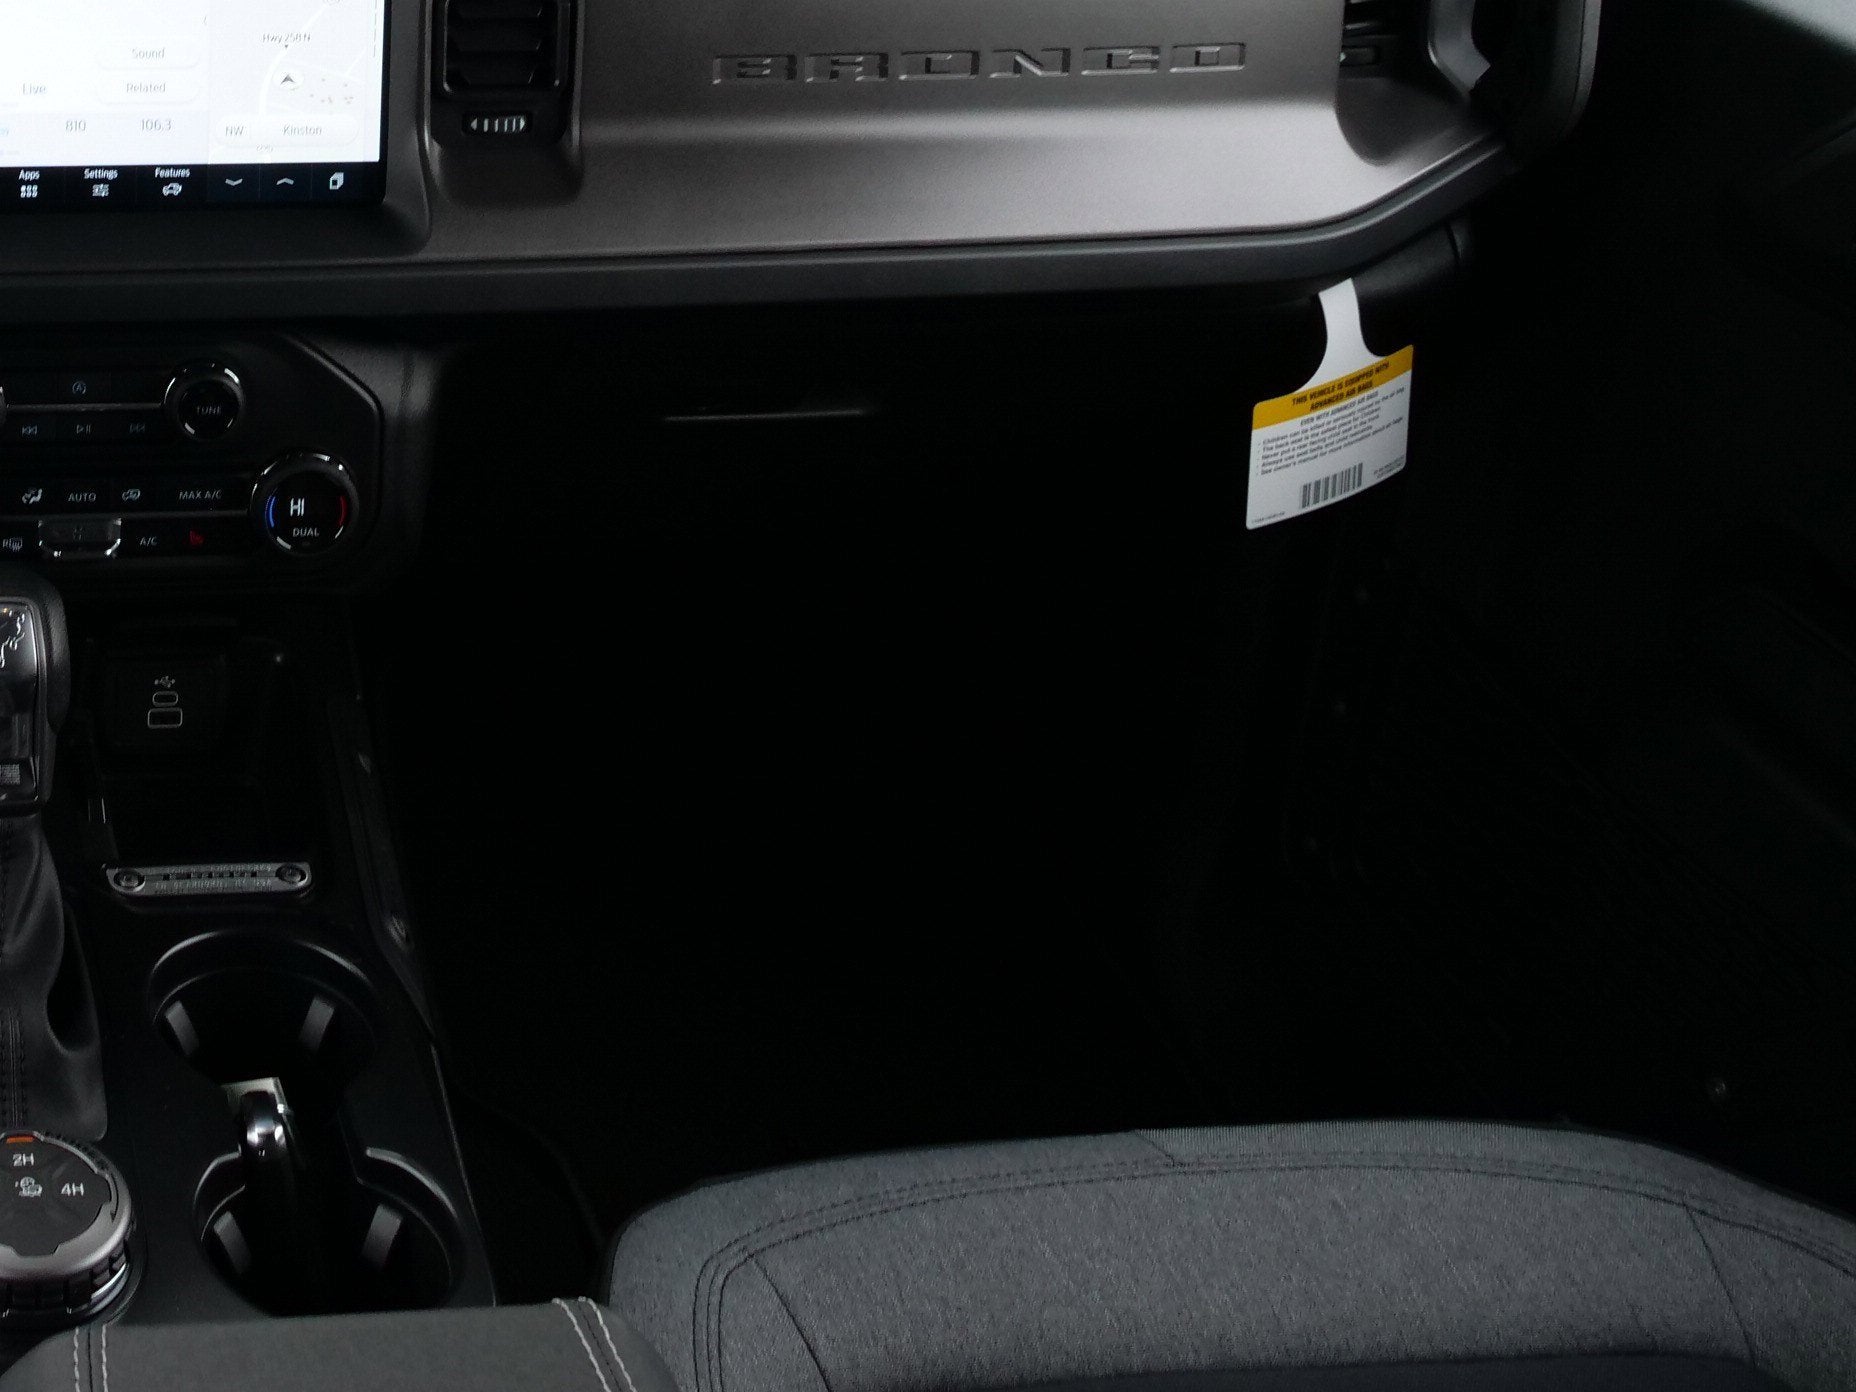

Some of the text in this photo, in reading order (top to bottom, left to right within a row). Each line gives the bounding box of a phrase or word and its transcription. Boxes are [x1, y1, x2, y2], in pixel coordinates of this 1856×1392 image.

[131, 48, 165, 60] Sound
[713, 42, 1246, 86] BRONCO
[23, 83, 47, 95] Live
[125, 82, 166, 93] Related
[140, 119, 173, 131] 106.3
[225, 126, 245, 136] NW
[283, 125, 322, 136] Kinston
[18, 169, 40, 181] Apps
[84, 168, 118, 180] Settings
[154, 167, 190, 178] Features
[68, 492, 96, 503] AUTO
[179, 489, 223, 500] MAX A/C
[290, 497, 305, 517] HI
[292, 527, 320, 538] DUAL
[139, 536, 158, 547] A/C
[12, 1152, 34, 1167] 2H
[60, 1182, 84, 1196] 4H
